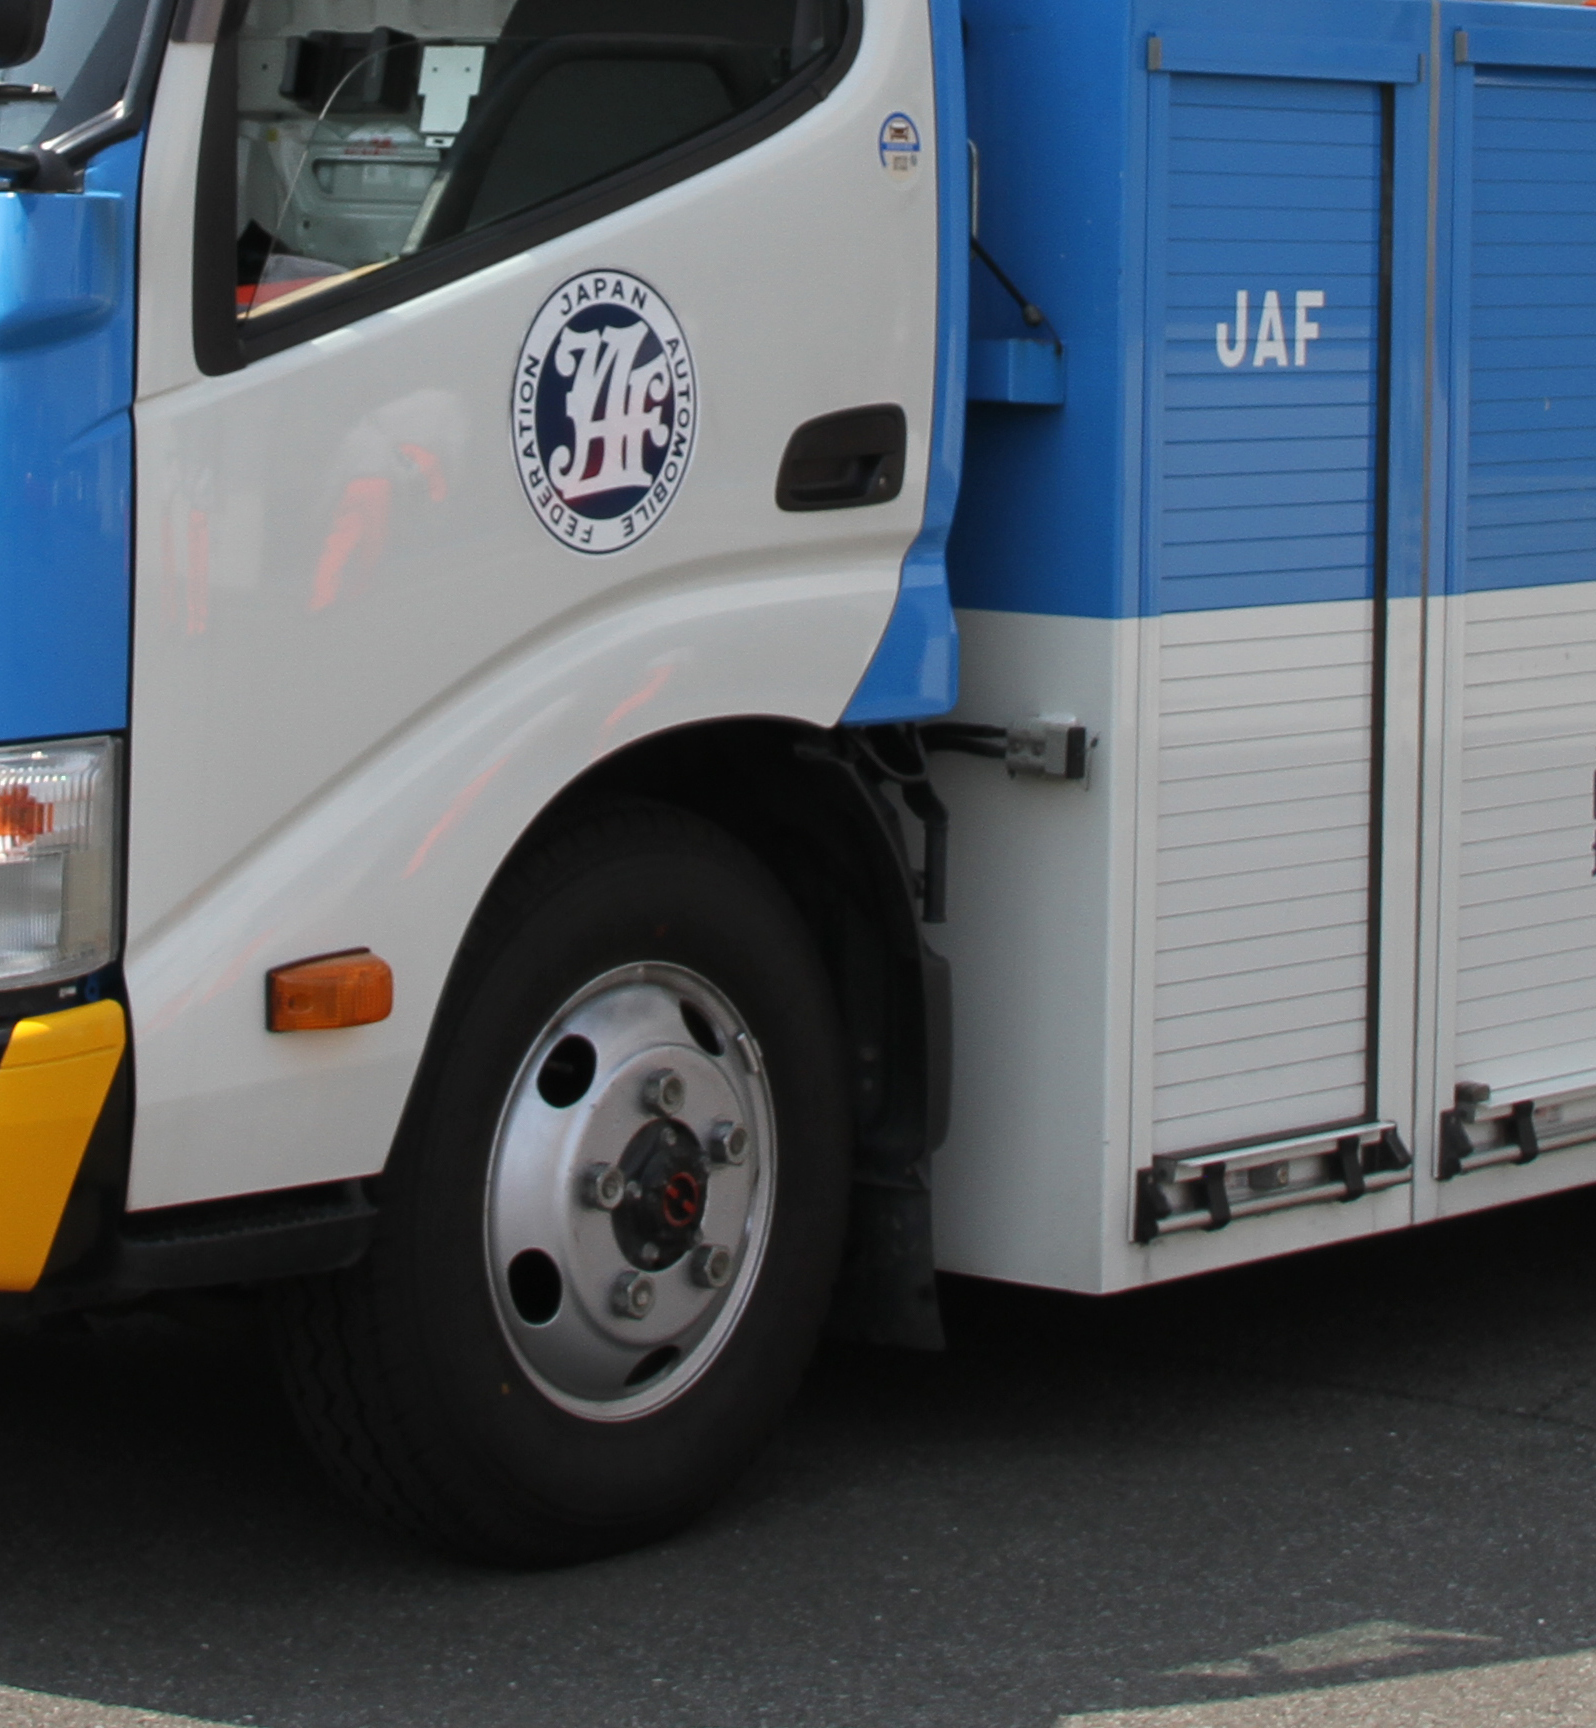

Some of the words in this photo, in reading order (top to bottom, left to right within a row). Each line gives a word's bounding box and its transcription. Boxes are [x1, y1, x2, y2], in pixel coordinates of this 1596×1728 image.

[559, 277, 648, 316] JAPAN
[1215, 289, 1325, 368] JAF
[517, 353, 595, 545] FEDERATION
[620, 335, 692, 539] AUTOMOBILE
